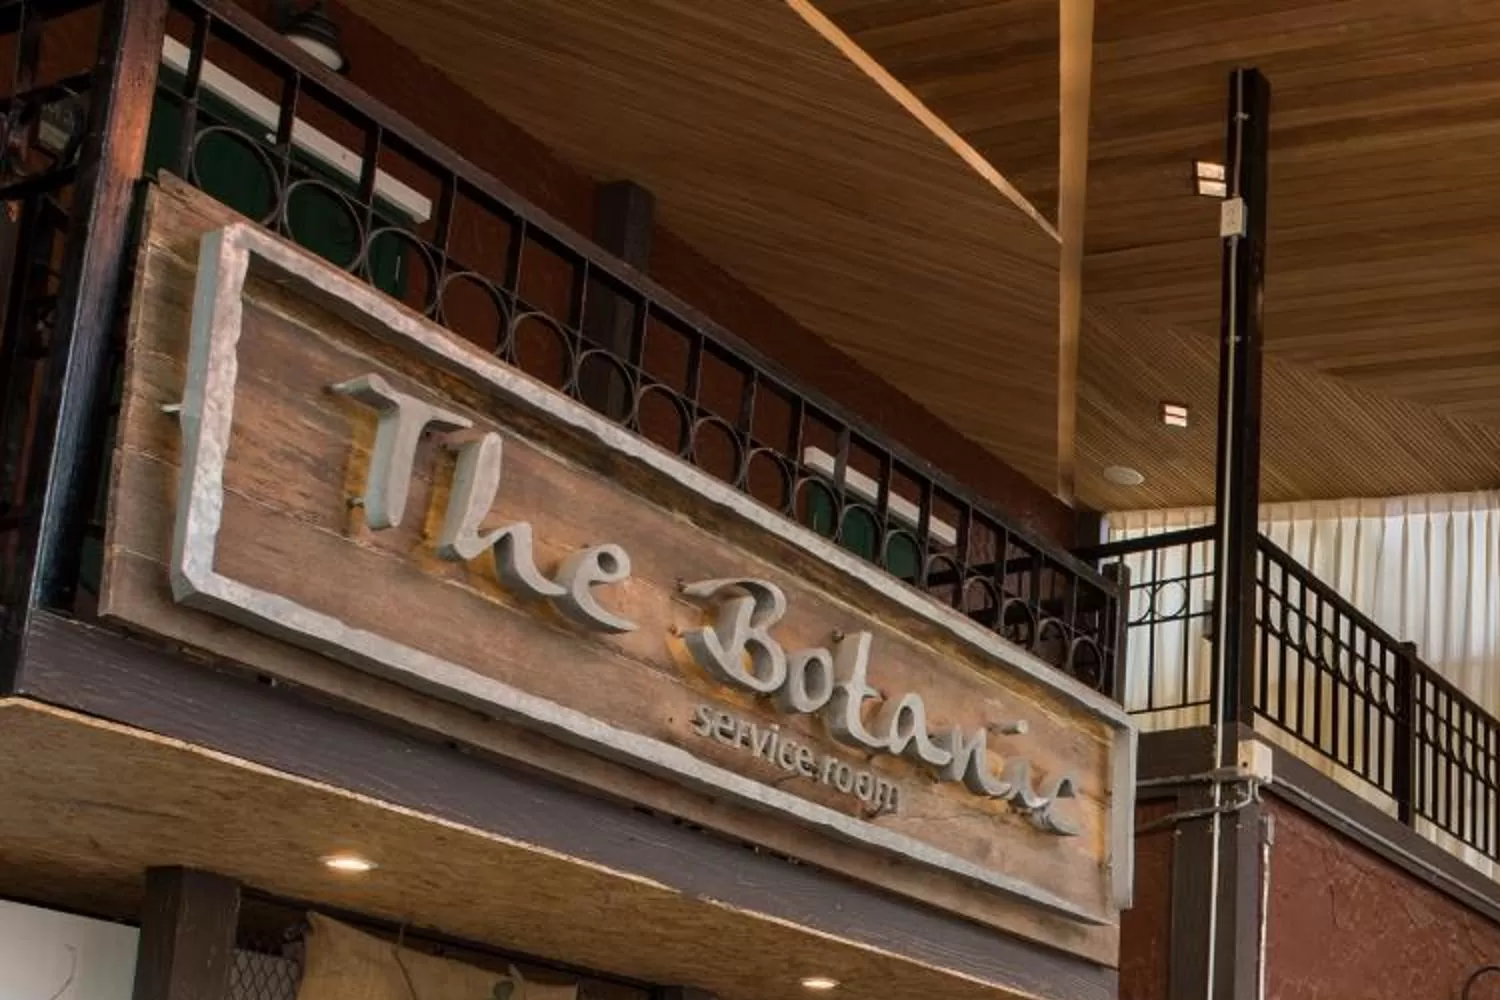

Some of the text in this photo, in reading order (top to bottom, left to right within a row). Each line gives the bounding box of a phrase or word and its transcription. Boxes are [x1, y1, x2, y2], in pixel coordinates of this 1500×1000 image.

[330, 366, 1081, 836] The Botanic
[697, 702, 899, 812] service room
